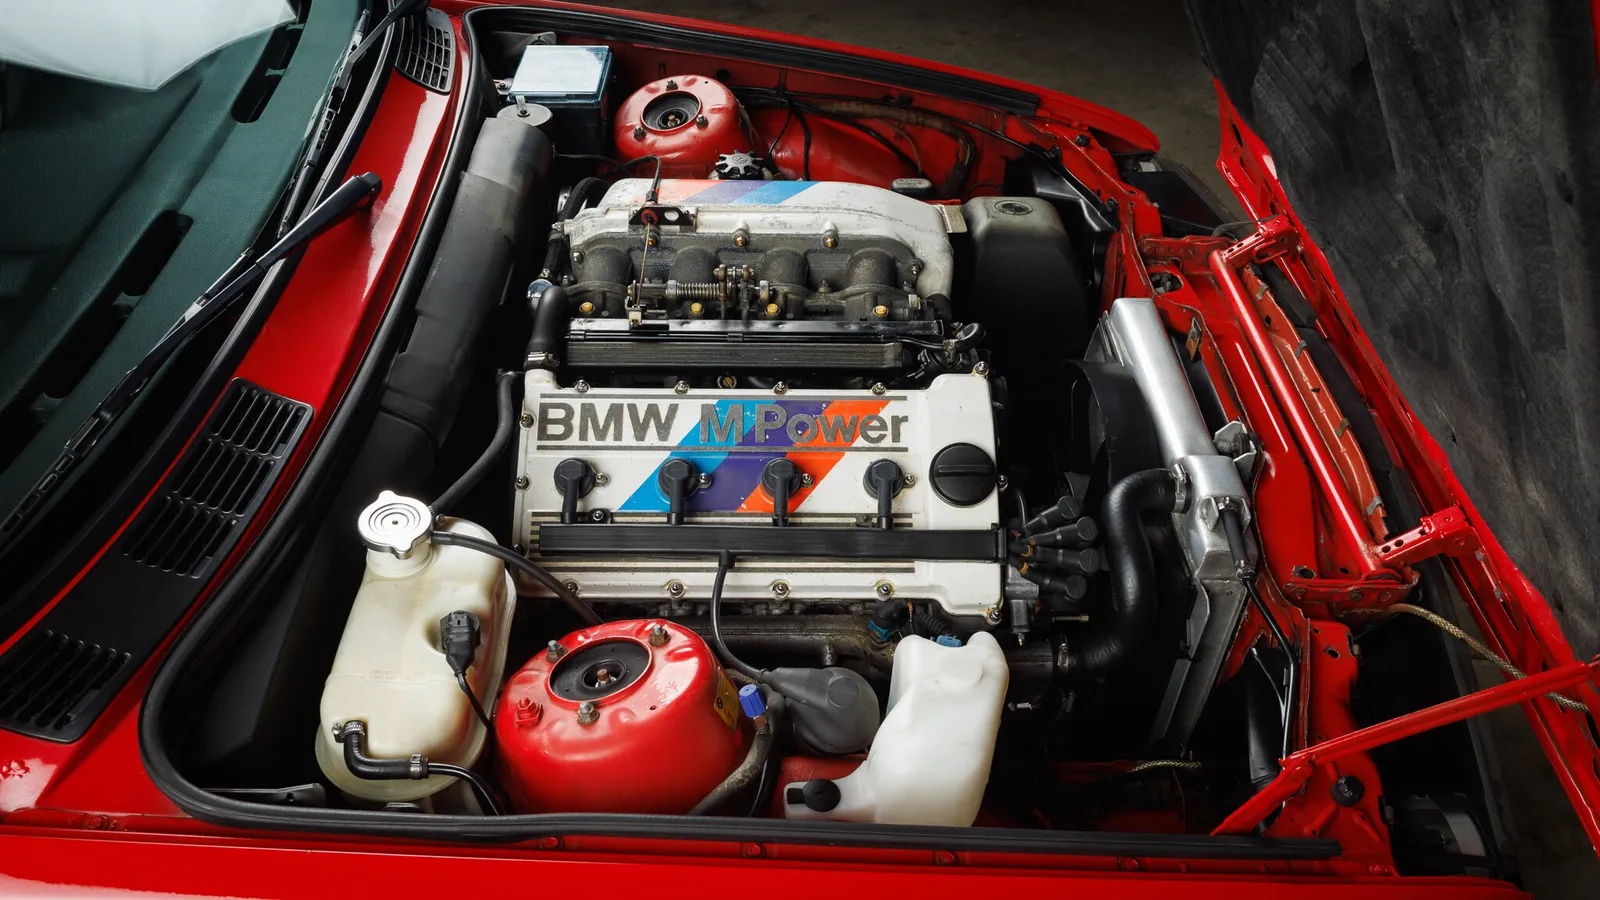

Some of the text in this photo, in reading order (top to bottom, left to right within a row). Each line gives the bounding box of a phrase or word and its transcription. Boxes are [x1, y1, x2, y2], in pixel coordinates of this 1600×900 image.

[537, 402, 908, 444] BMW M Power
